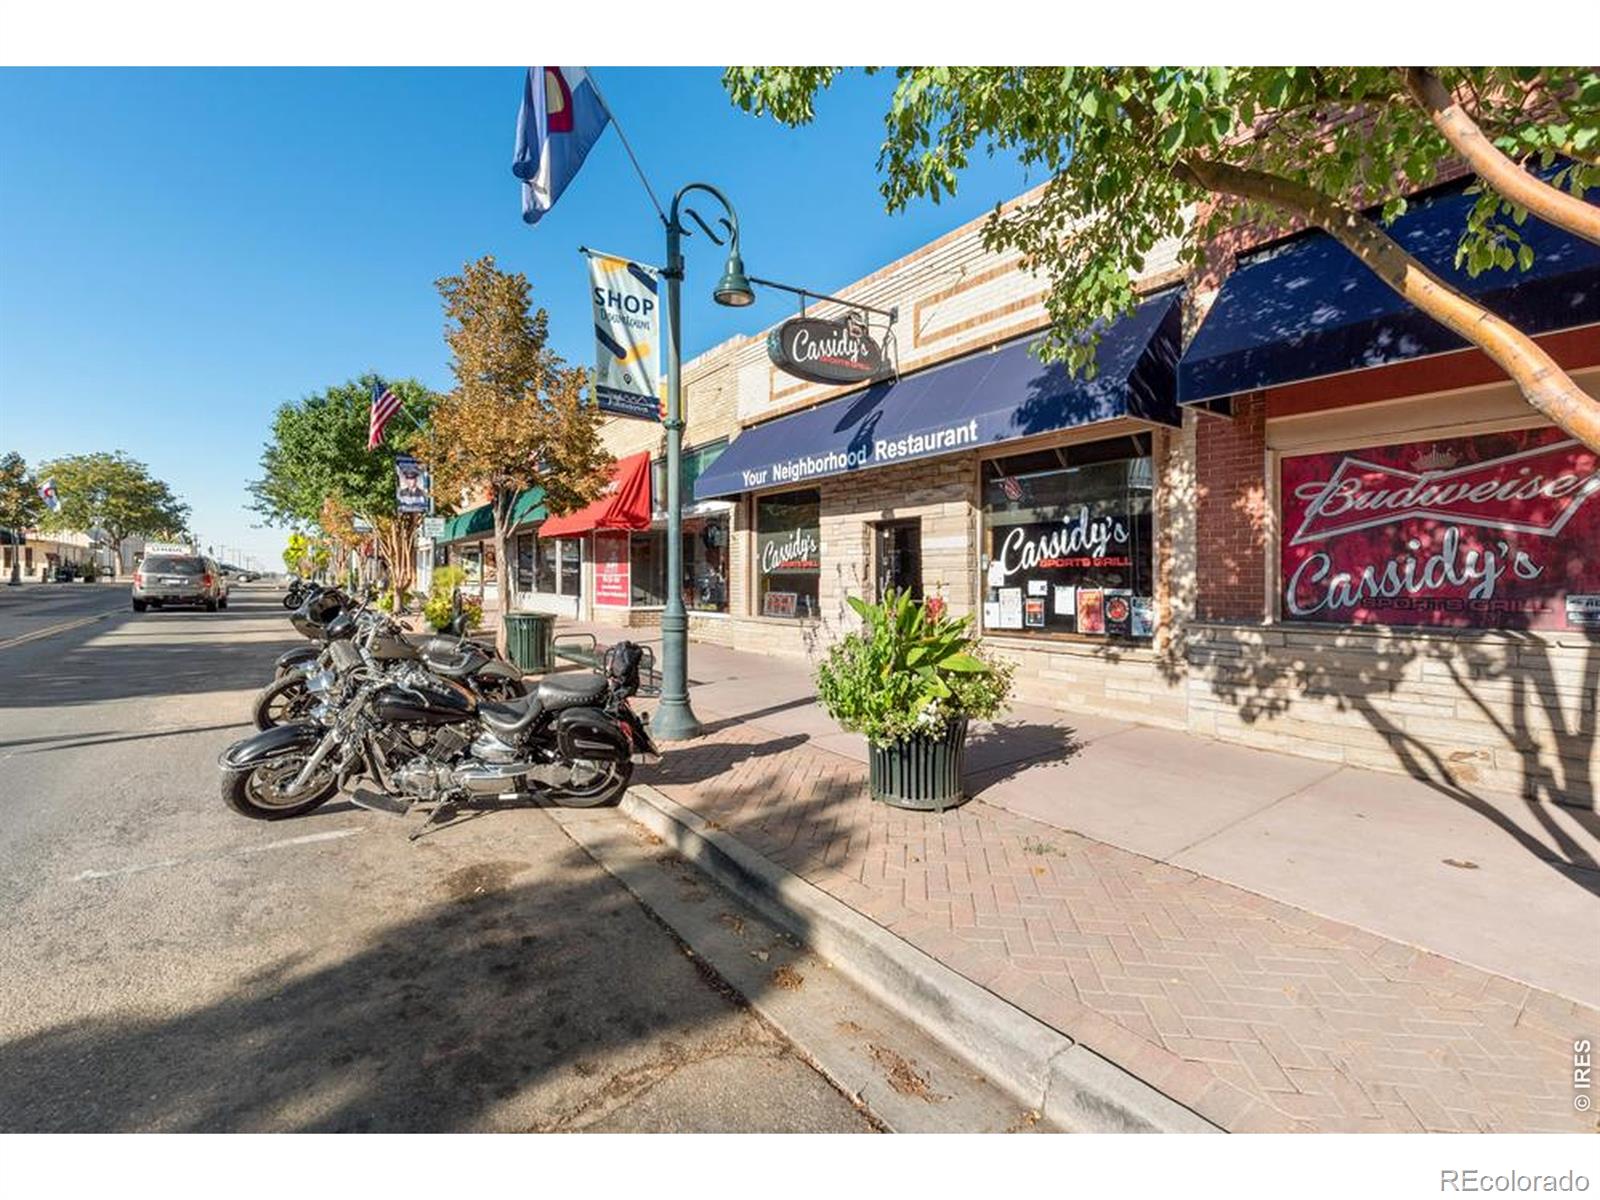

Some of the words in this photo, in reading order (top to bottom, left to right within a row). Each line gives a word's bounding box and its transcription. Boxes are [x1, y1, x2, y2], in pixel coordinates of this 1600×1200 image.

[594, 287, 654, 315] SHOP
[793, 328, 869, 362] Cassidy's
[742, 469, 766, 487] Your
[772, 446, 867, 481] Neighborhood
[875, 419, 978, 461] Restaurant
[763, 528, 817, 573] Cassidy's
[1001, 507, 1129, 576] Cassidy's
[1040, 557, 1091, 568] SPORTS
[1092, 555, 1133, 567] GRILL
[1287, 526, 1544, 615] Cassidy's
